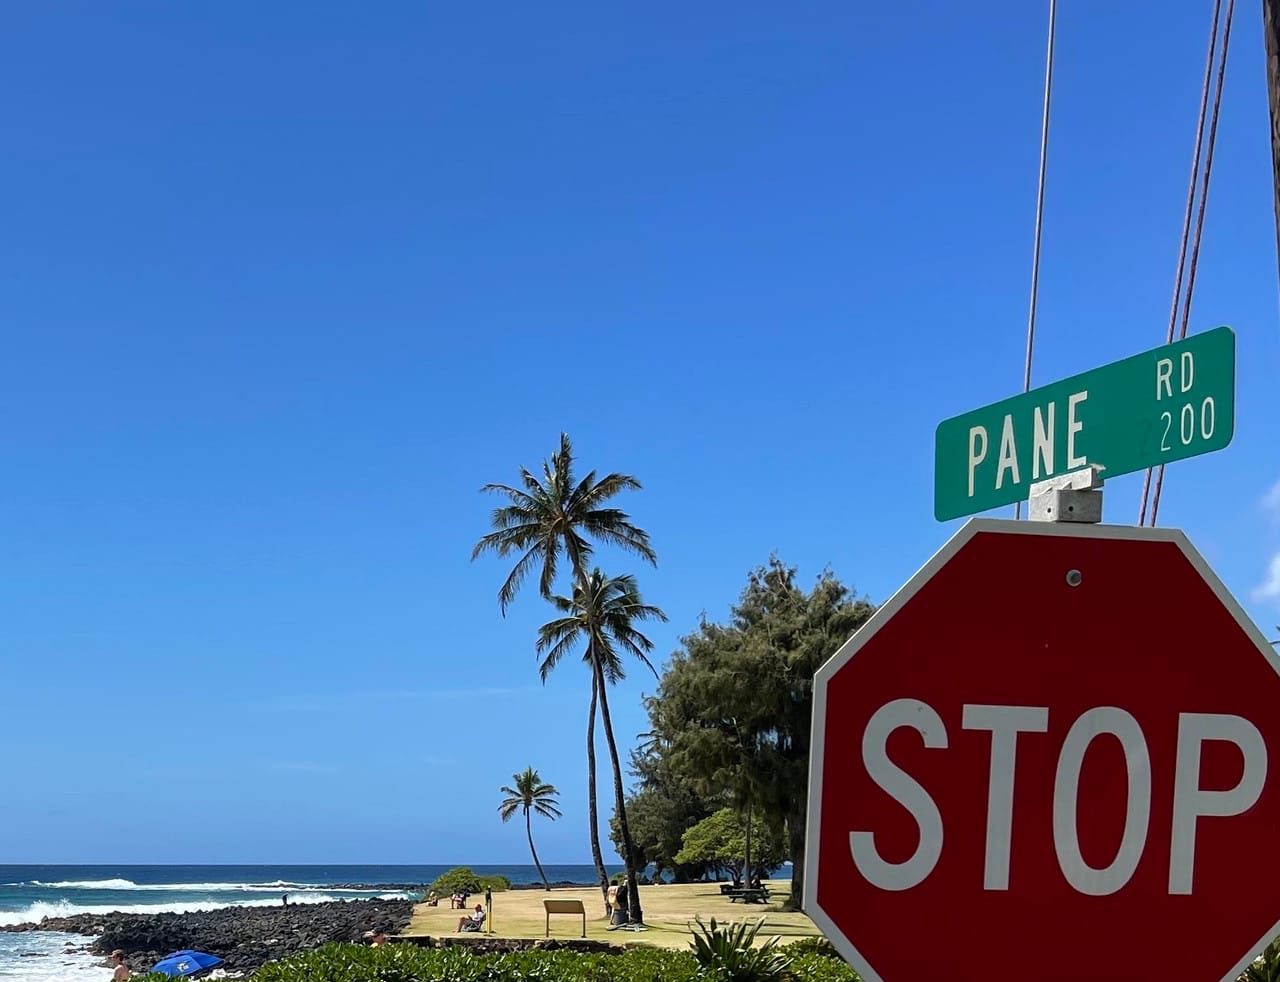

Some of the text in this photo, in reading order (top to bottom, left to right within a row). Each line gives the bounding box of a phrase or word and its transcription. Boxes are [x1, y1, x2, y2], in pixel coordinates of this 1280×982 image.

[968, 351, 1195, 497] PANE RD
[1160, 396, 1215, 452] 200
[849, 698, 1268, 896] STOP
